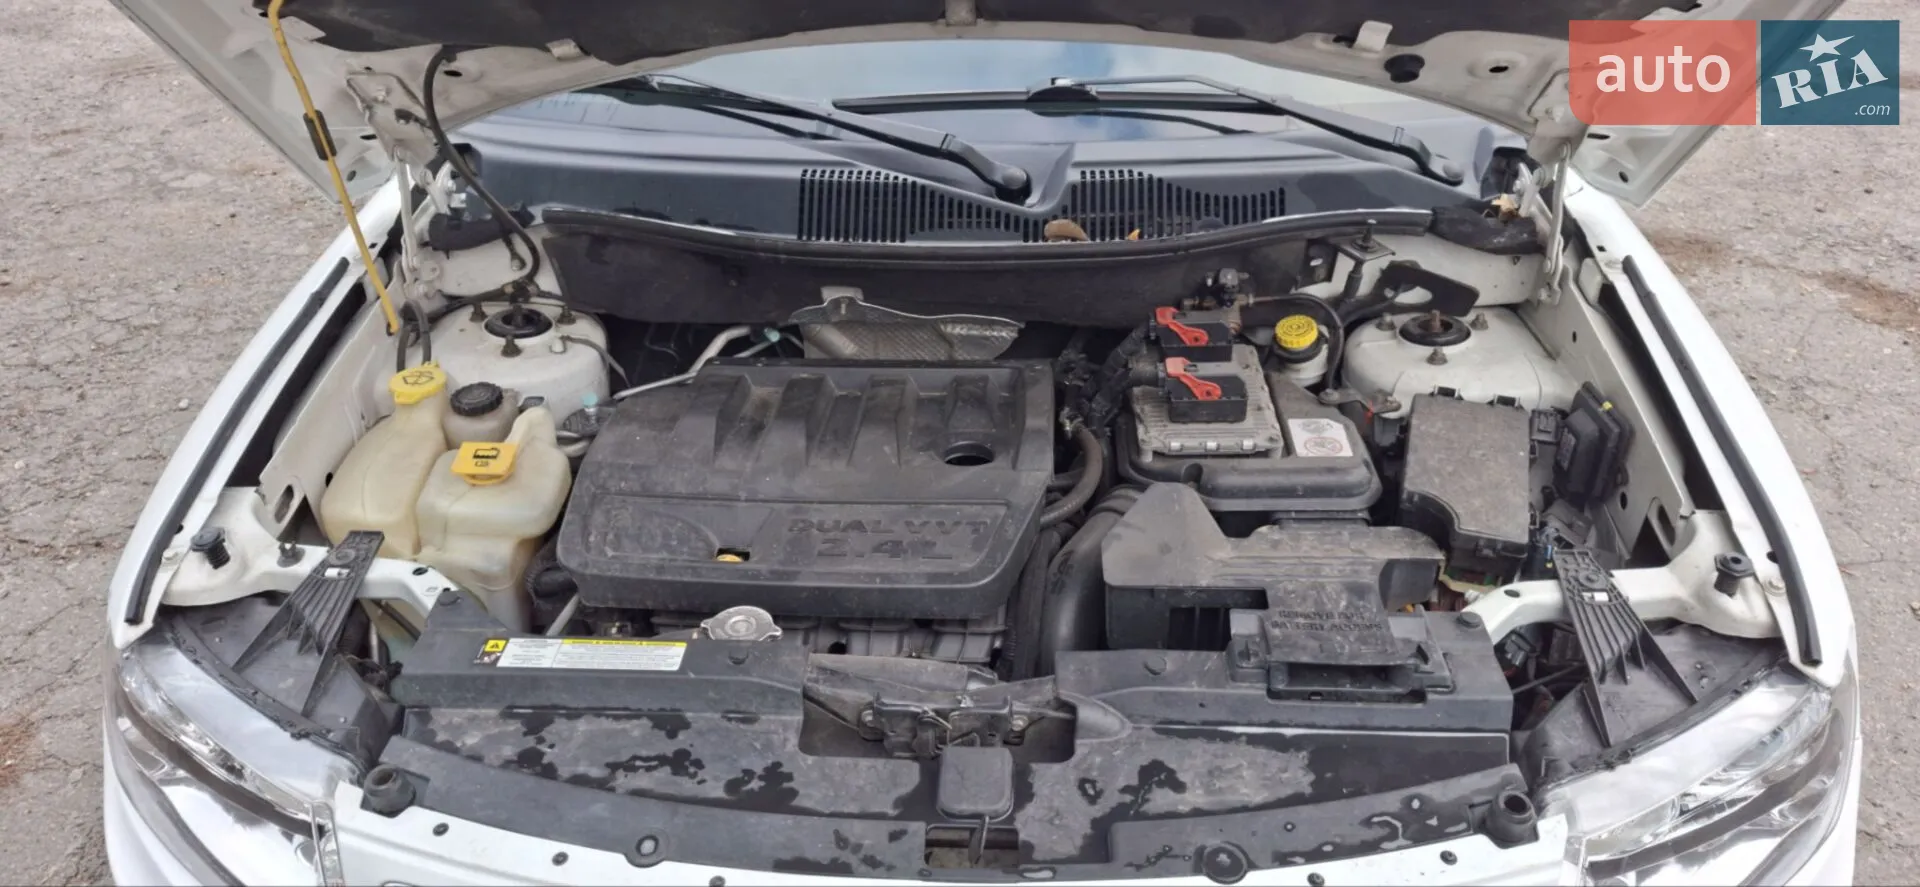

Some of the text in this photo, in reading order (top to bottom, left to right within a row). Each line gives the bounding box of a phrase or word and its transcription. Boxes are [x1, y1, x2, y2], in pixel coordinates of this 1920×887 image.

[787, 518, 990, 535] DUAL VVT
[816, 537, 953, 560] 2.4L
